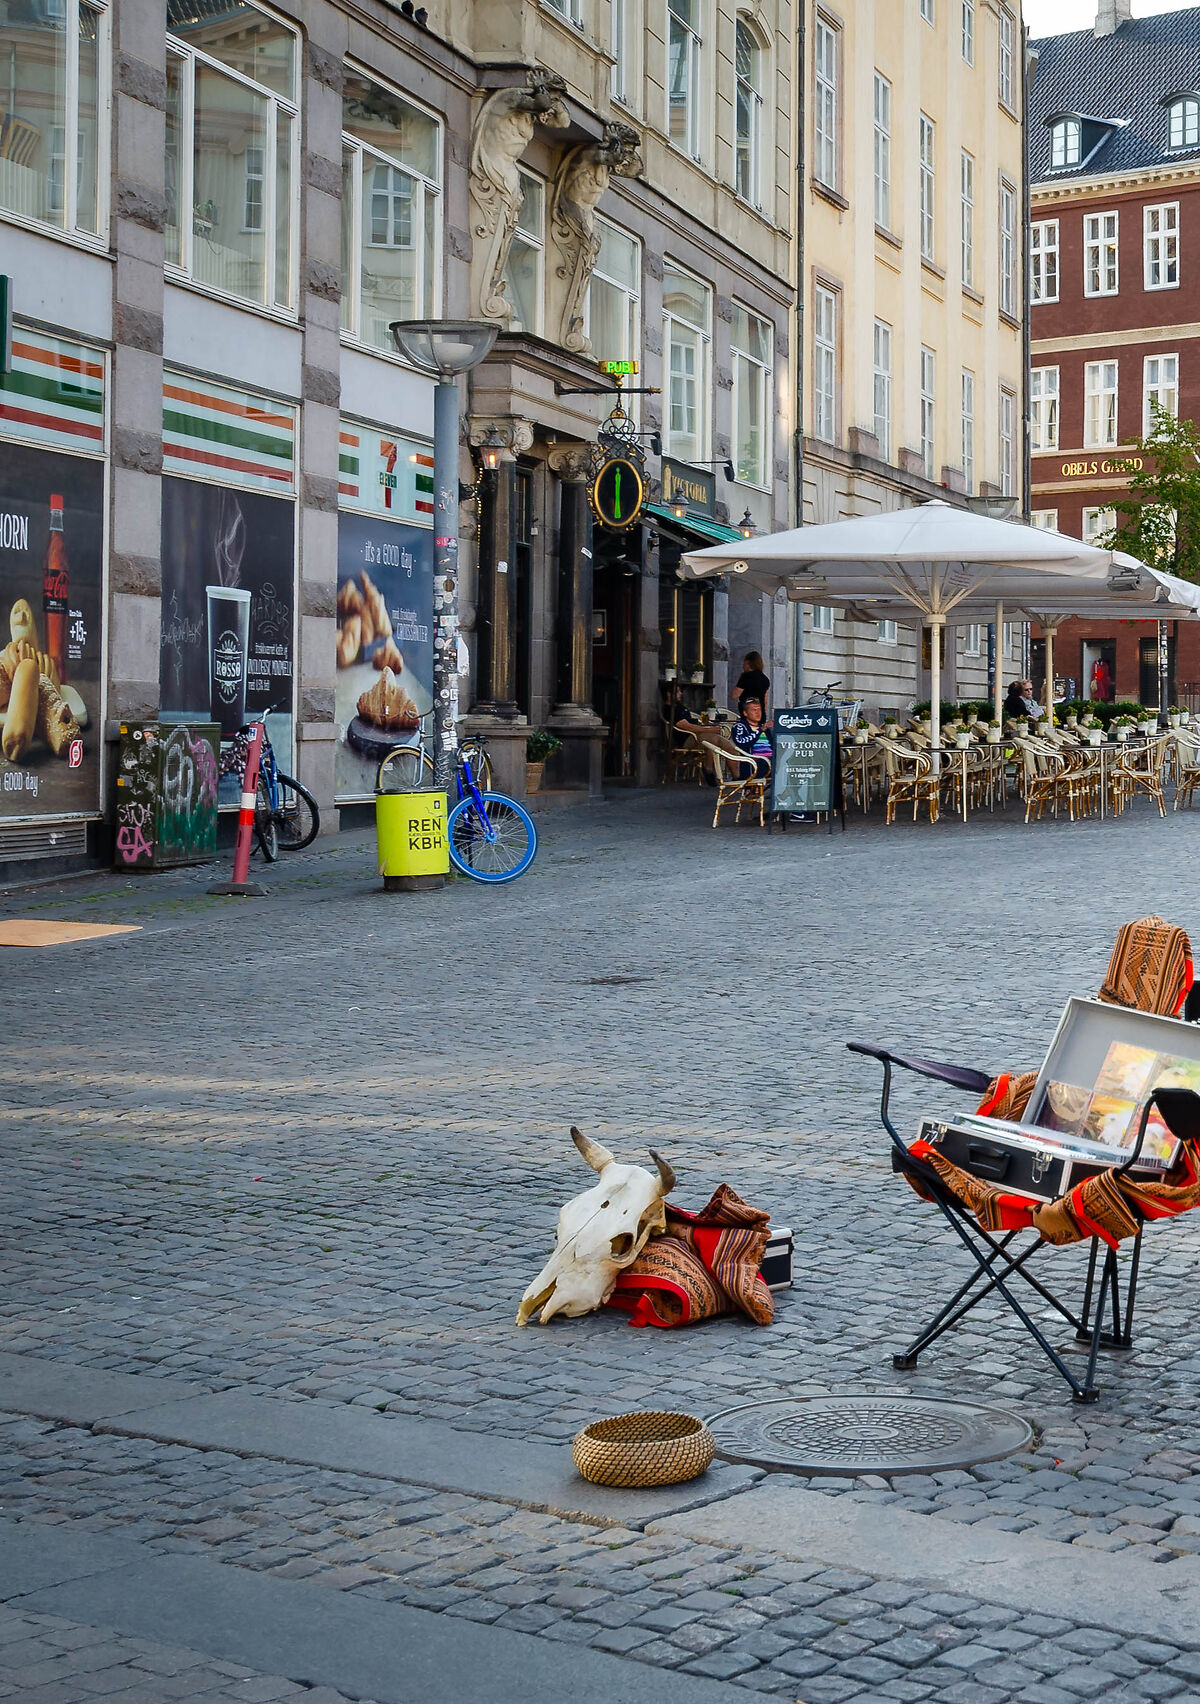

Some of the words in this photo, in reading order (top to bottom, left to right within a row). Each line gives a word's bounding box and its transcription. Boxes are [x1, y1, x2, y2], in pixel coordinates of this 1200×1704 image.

[607, 361, 631, 373] PUB
[1061, 461, 1098, 476] OBELS
[671, 475, 707, 504] VICTORIA
[383, 543, 399, 566] GOOD
[216, 660, 241, 678] ROSSO
[778, 714, 813, 729] Carlsberg
[781, 741, 828, 749] VICTORIA
[795, 750, 814, 758] PUB
[4, 772, 23, 791] GOOD
[25, 771, 39, 797] day
[408, 818, 442, 832] REN
[408, 836, 442, 850] KBH
